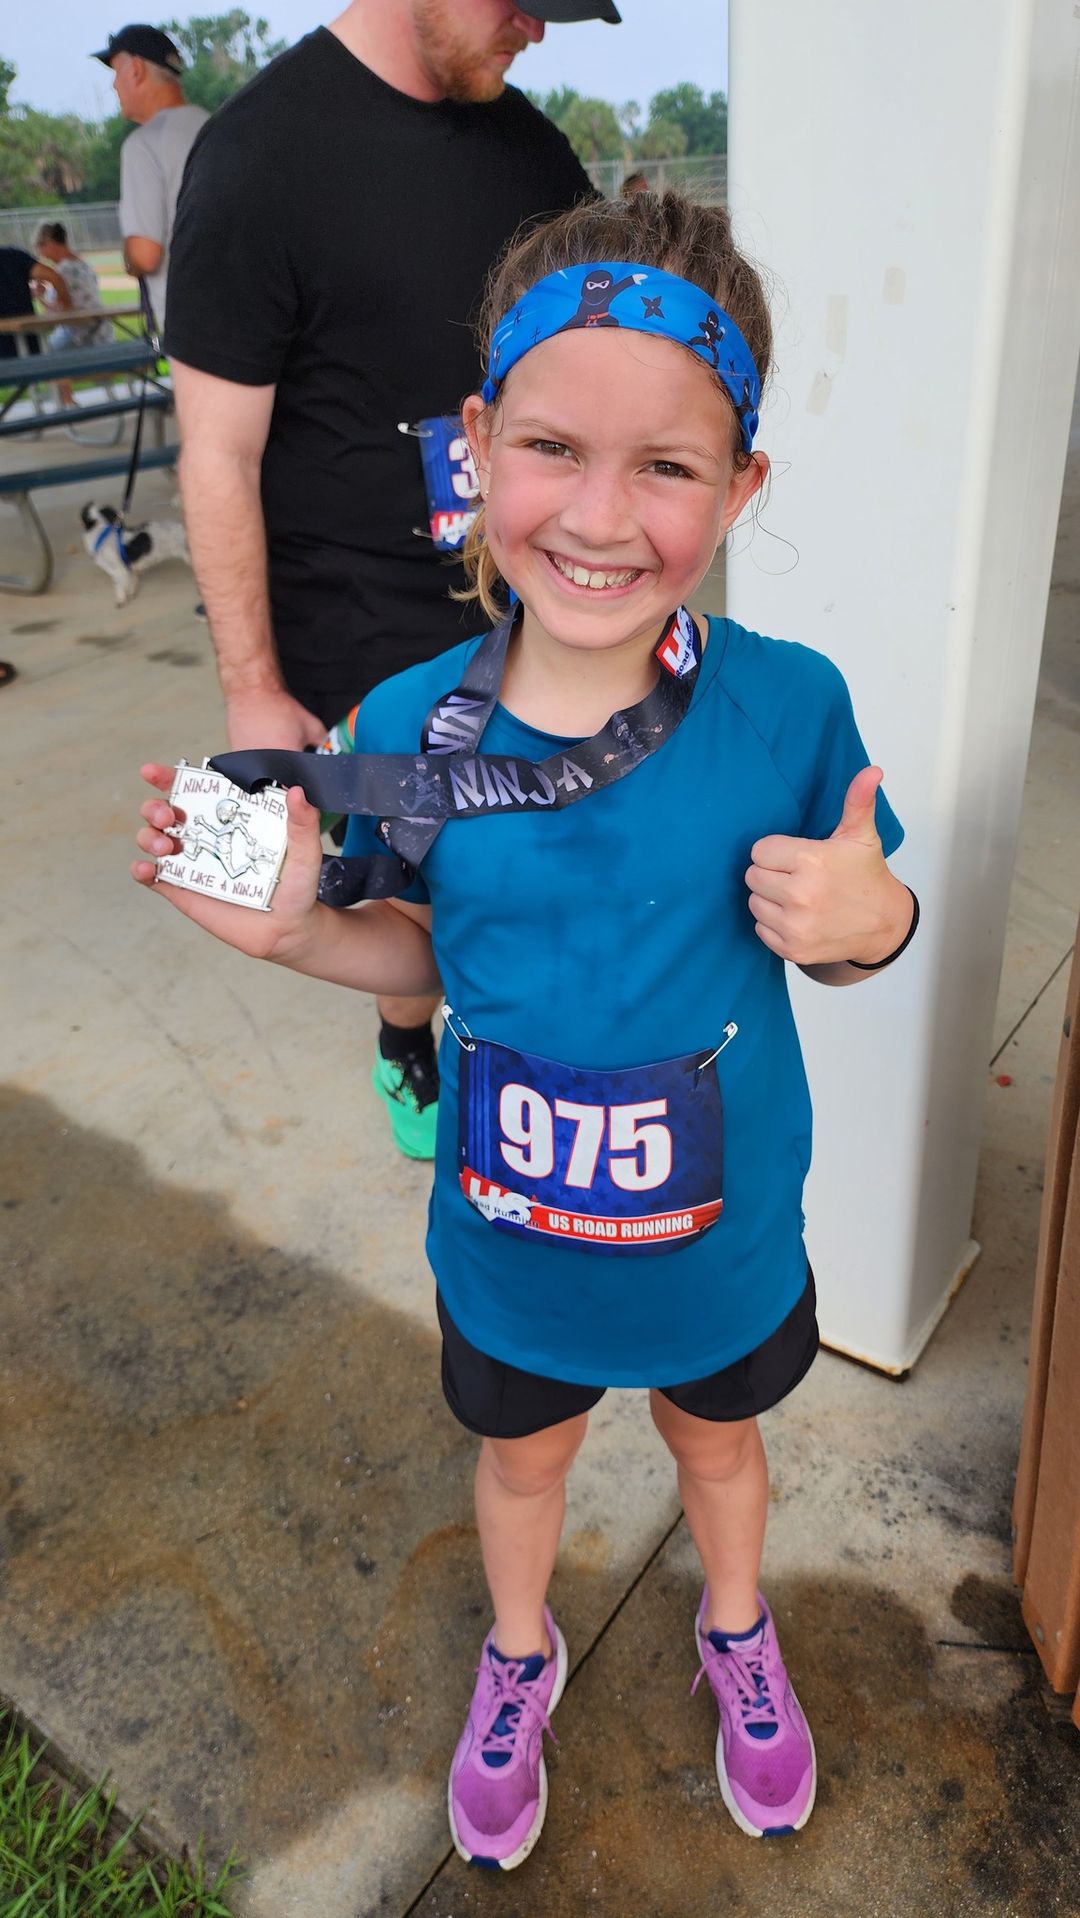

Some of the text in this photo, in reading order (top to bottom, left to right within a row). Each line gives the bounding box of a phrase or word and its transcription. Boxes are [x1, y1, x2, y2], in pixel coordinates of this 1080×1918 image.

[676, 650, 690, 678] Road
[183, 778, 220, 795] NINJA
[449, 757, 594, 811] NINJA
[163, 860, 264, 899] RUN LIKE A NINJA
[500, 1083, 672, 1192] 975
[548, 1213, 694, 1238] US ROAD RUNNING
